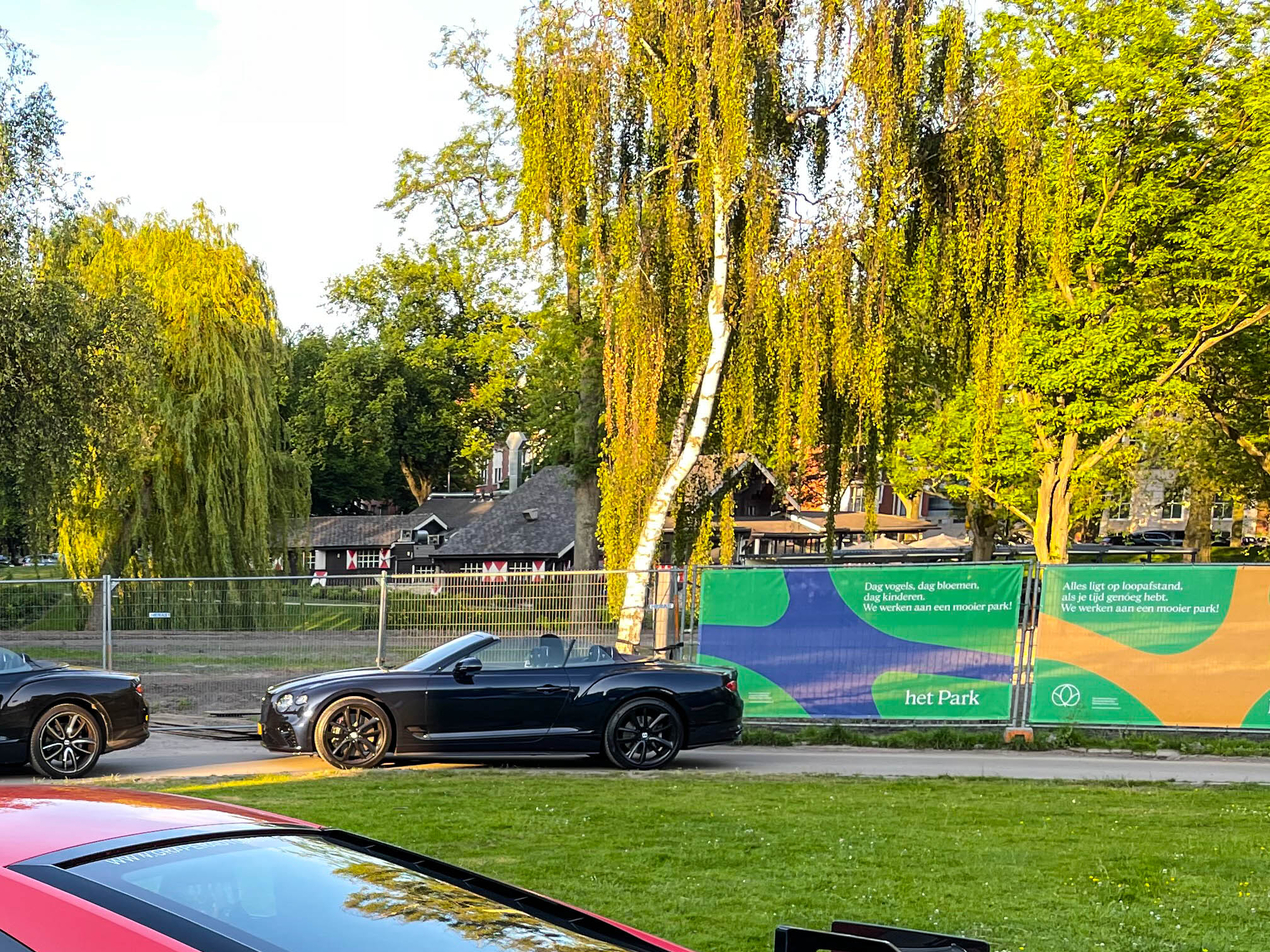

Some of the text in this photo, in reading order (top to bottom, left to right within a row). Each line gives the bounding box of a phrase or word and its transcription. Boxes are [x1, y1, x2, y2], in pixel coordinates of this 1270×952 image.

[864, 582, 883, 592] Dag
[917, 581, 936, 592] dag
[1062, 581, 1087, 591] Alles
[1089, 581, 1105, 593] ligt
[1107, 583, 1120, 593] op
[863, 592, 925, 603] dag kinderen.
[1061, 593, 1076, 602] als
[1077, 593, 1087, 603] je
[1088, 592, 1105, 603] tijd
[1143, 592, 1168, 602] hebt.
[863, 601, 1013, 612] We werken aan een mooier park!
[1061, 603, 1219, 614] We werken aan een mooier park!
[904, 689, 980, 705] het Park
